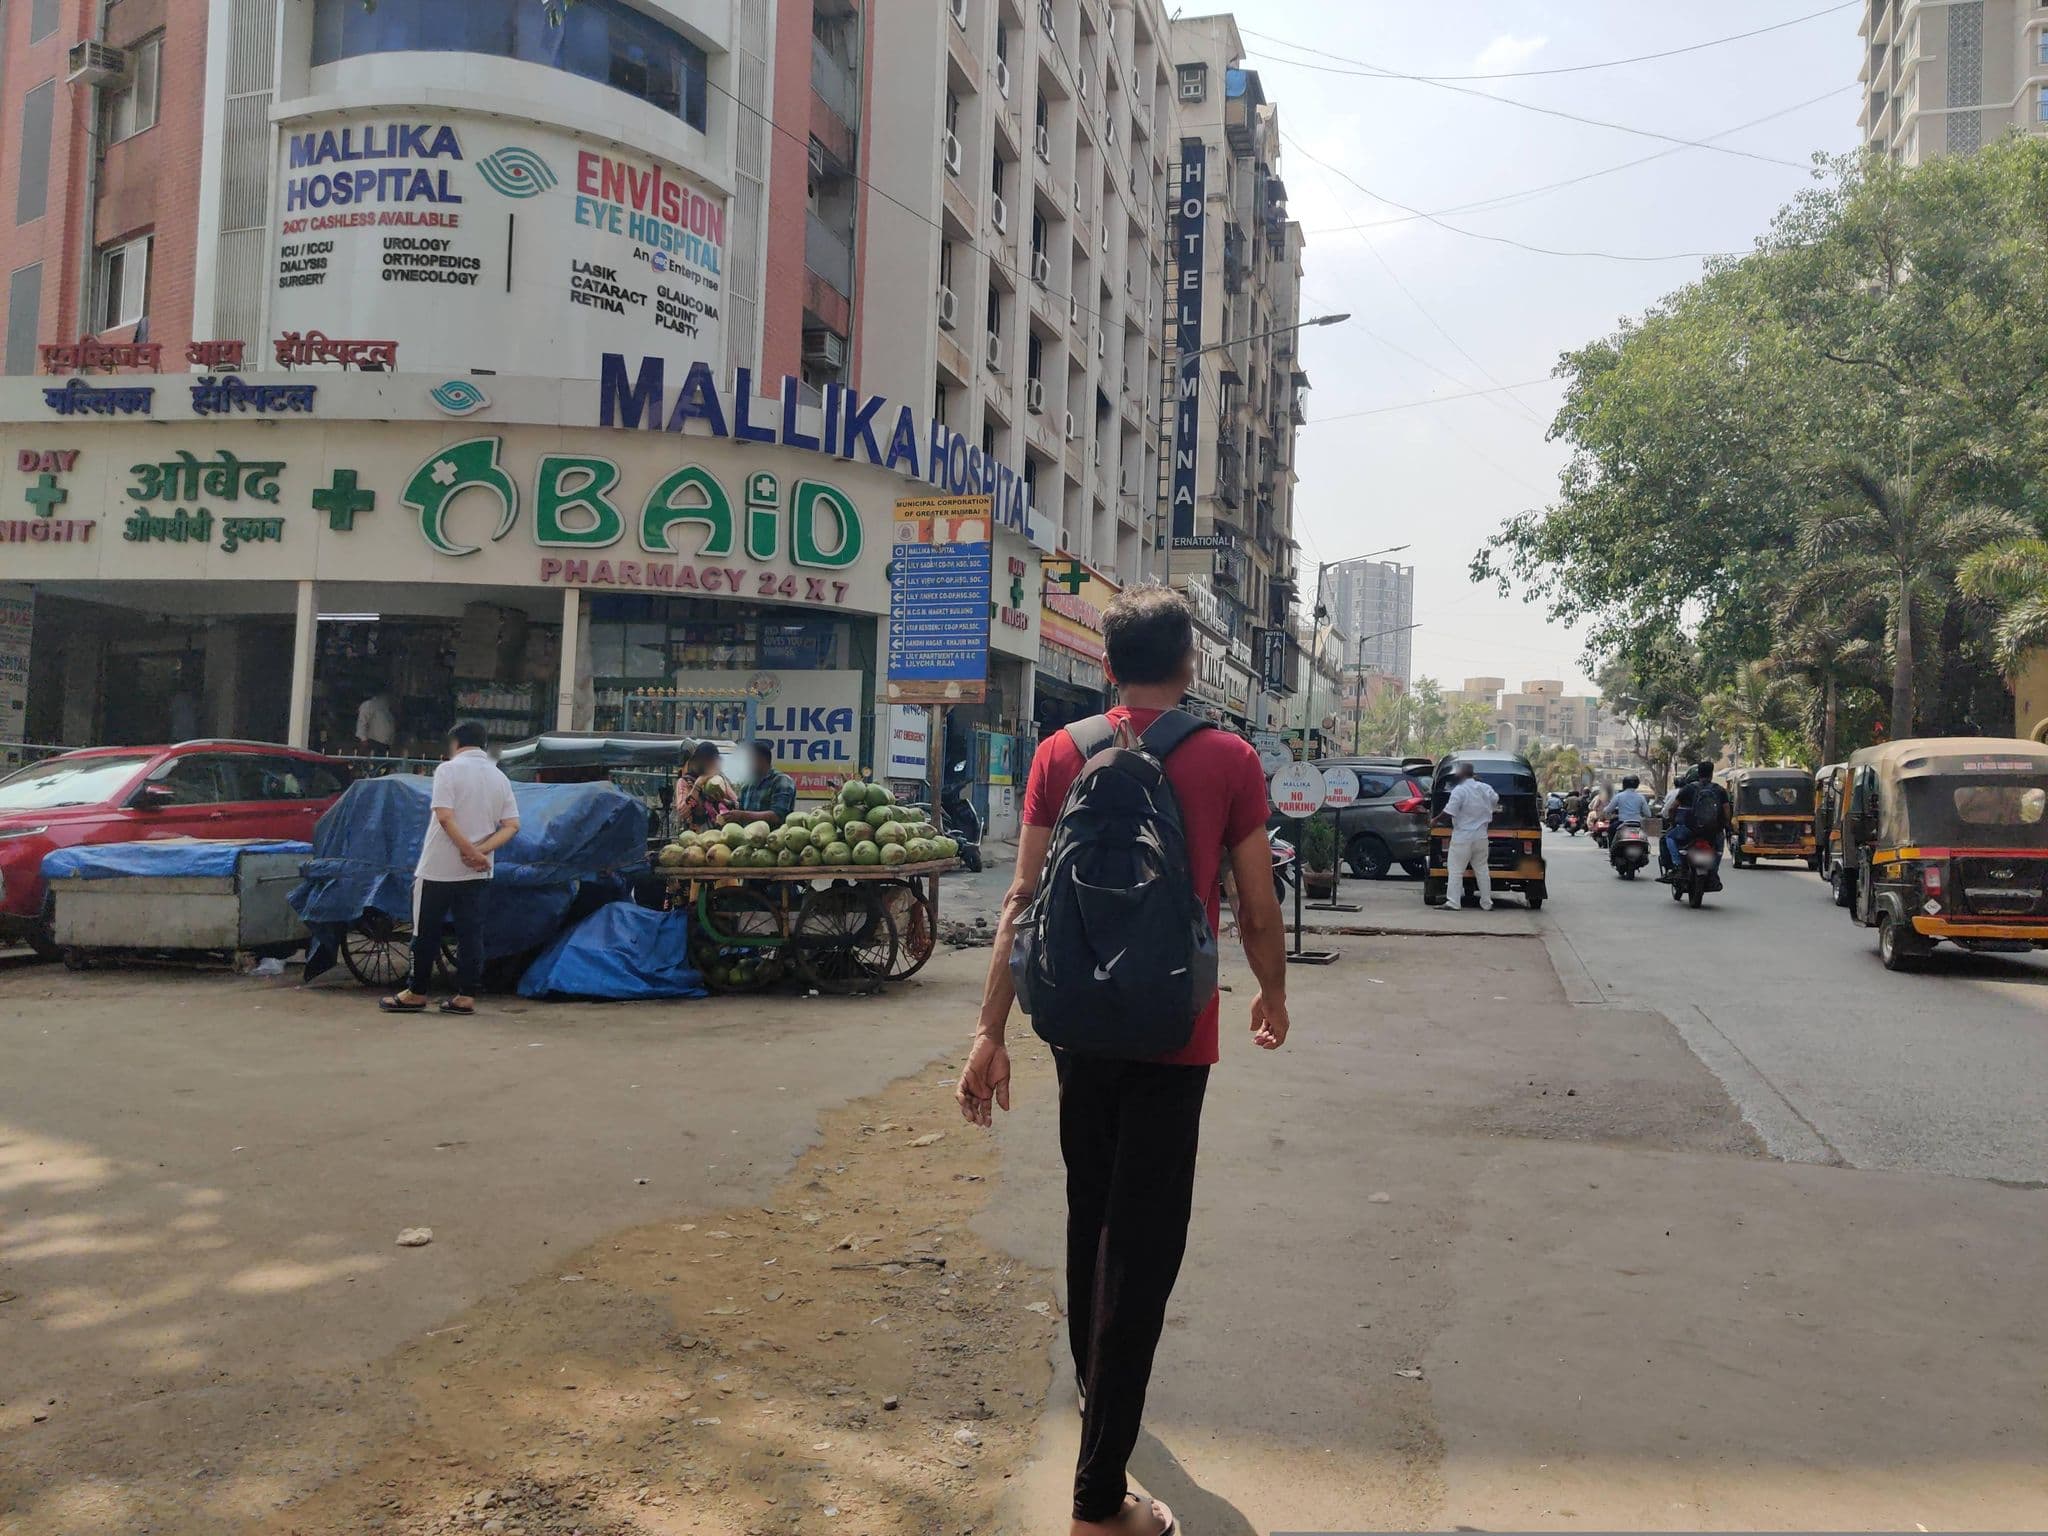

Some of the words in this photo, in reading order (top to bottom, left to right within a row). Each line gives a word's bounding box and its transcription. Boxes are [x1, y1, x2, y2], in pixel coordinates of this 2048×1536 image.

[290, 125, 463, 169] MALLIKA
[286, 169, 462, 212] HOSPITAL
[311, 213, 375, 231] CASHLESS
[378, 211, 459, 228] AVAILABLE
[383, 237, 450, 251] UROLOGY
[575, 195, 624, 236] EYE
[629, 210, 721, 276] HOSPITAL
[1182, 163, 1202, 326] HOTEL
[281, 245, 299, 258] ICU
[307, 241, 334, 255] ICCU
[633, 247, 650, 262] An
[280, 258, 328, 273] DIALYSIS
[382, 254, 481, 270] ORTHOPEDICS
[572, 259, 617, 283] LASIK
[279, 273, 326, 288] SURGERY
[382, 269, 479, 286] GYNECOLOGY
[570, 290, 625, 315] RETINA
[571, 275, 648, 306] CATARACT
[656, 284, 719, 321] GLAUCOMA
[656, 300, 698, 324] SQUINT
[655, 314, 699, 340] PLASTY
[273, 330, 399, 368] हॉस्पिटल
[189, 375, 318, 416] हॉस्पिटल
[600, 352, 920, 480] MALLIKA
[929, 417, 1035, 541] HOSPITAL
[1174, 376, 1198, 506] MINA
[18, 449, 80, 473] DAY
[126, 450, 286, 504] ओबेद
[937, 498, 989, 506] CORPORATION
[220, 517, 286, 553] दुकान
[1161, 537, 1230, 546] ITERNATIONAL
[1008, 556, 1026, 578] DA
[541, 558, 747, 592] PHARMACY
[757, 571, 798, 598] 24
[805, 576, 827, 601] X
[832, 580, 850, 603] 7
[1002, 606, 1029, 631] NIGH
[685, 706, 853, 734] MALIKA
[752, 738, 851, 762] PITAL
[800, 775, 845, 788] Availb
[1279, 801, 1316, 812] PARKING
[1291, 791, 1303, 801] NO
